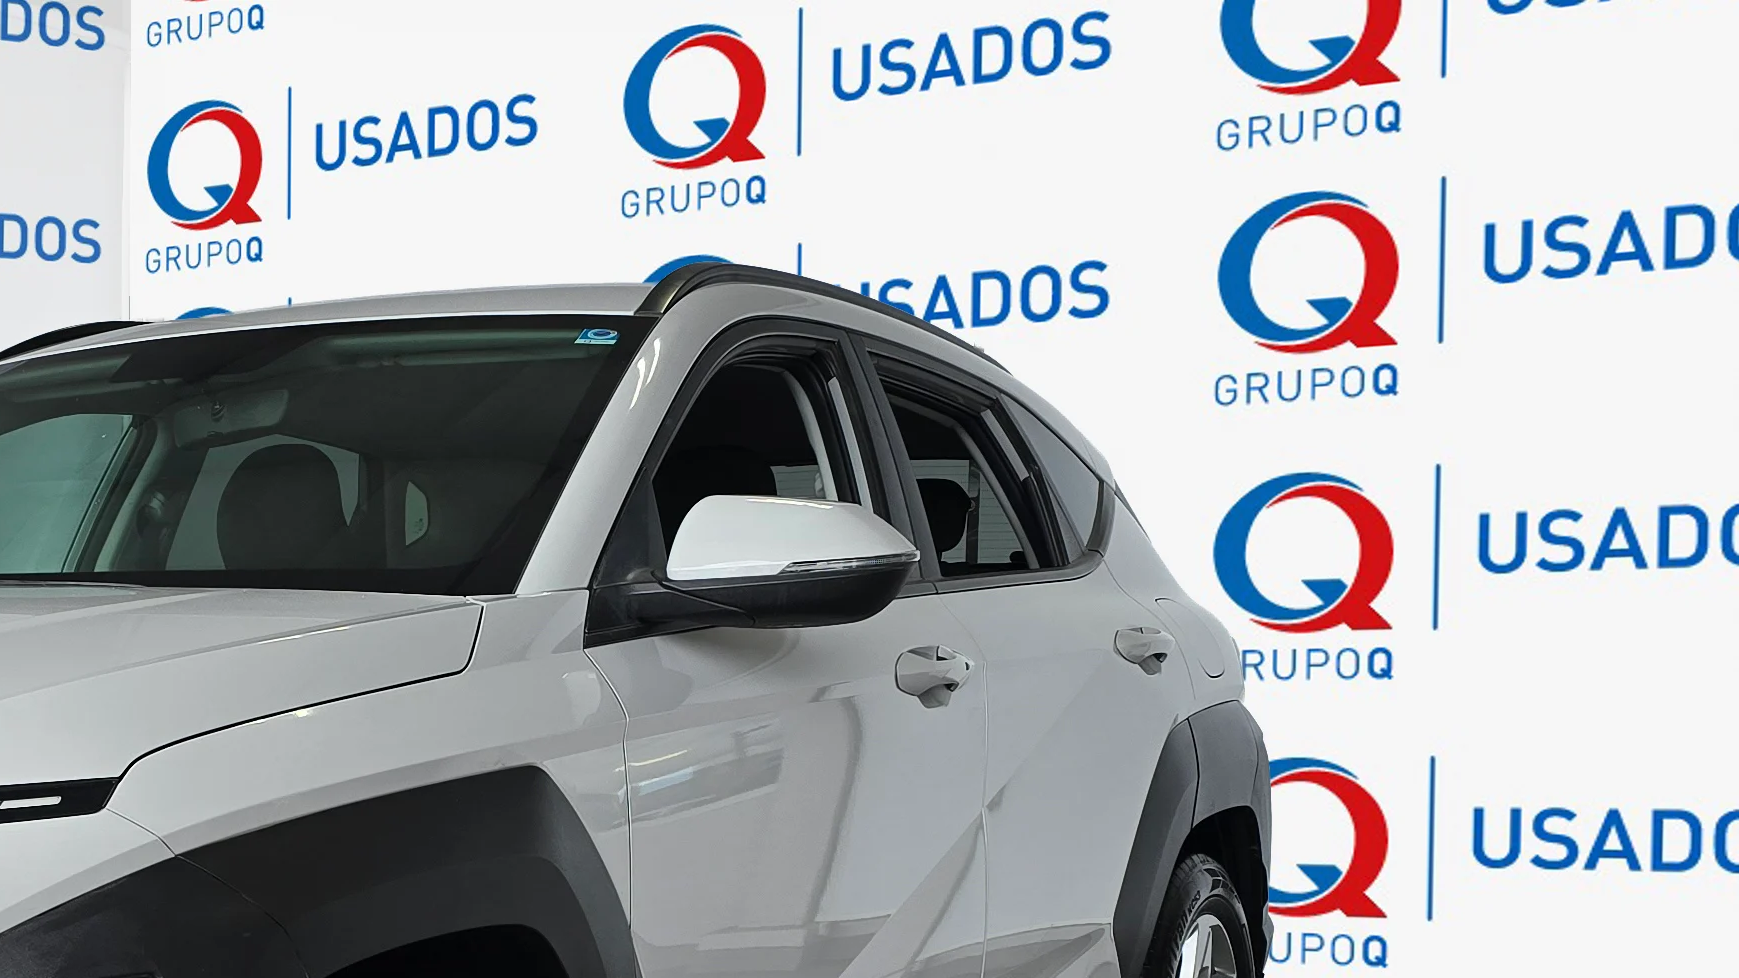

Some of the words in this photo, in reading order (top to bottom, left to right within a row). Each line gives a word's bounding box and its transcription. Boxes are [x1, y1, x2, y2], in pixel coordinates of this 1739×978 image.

[145, 3, 266, 49] GRUPOQ
[830, 9, 1112, 103] USADOS
[314, 92, 540, 173] USADOS
[1214, 99, 1403, 152] GRUPOQ
[620, 173, 767, 220] GRUPOQ
[144, 235, 264, 275] GRUPOQ
[1482, 202, 1739, 286] USAD
[833, 258, 1111, 331] SADOS
[1213, 361, 1399, 407] GRUPOQ
[1476, 502, 1739, 576] USAD
[1240, 645, 1395, 682] RUPOQ
[1470, 805, 1739, 875] USAD
[1267, 931, 1389, 969] UPOQ
